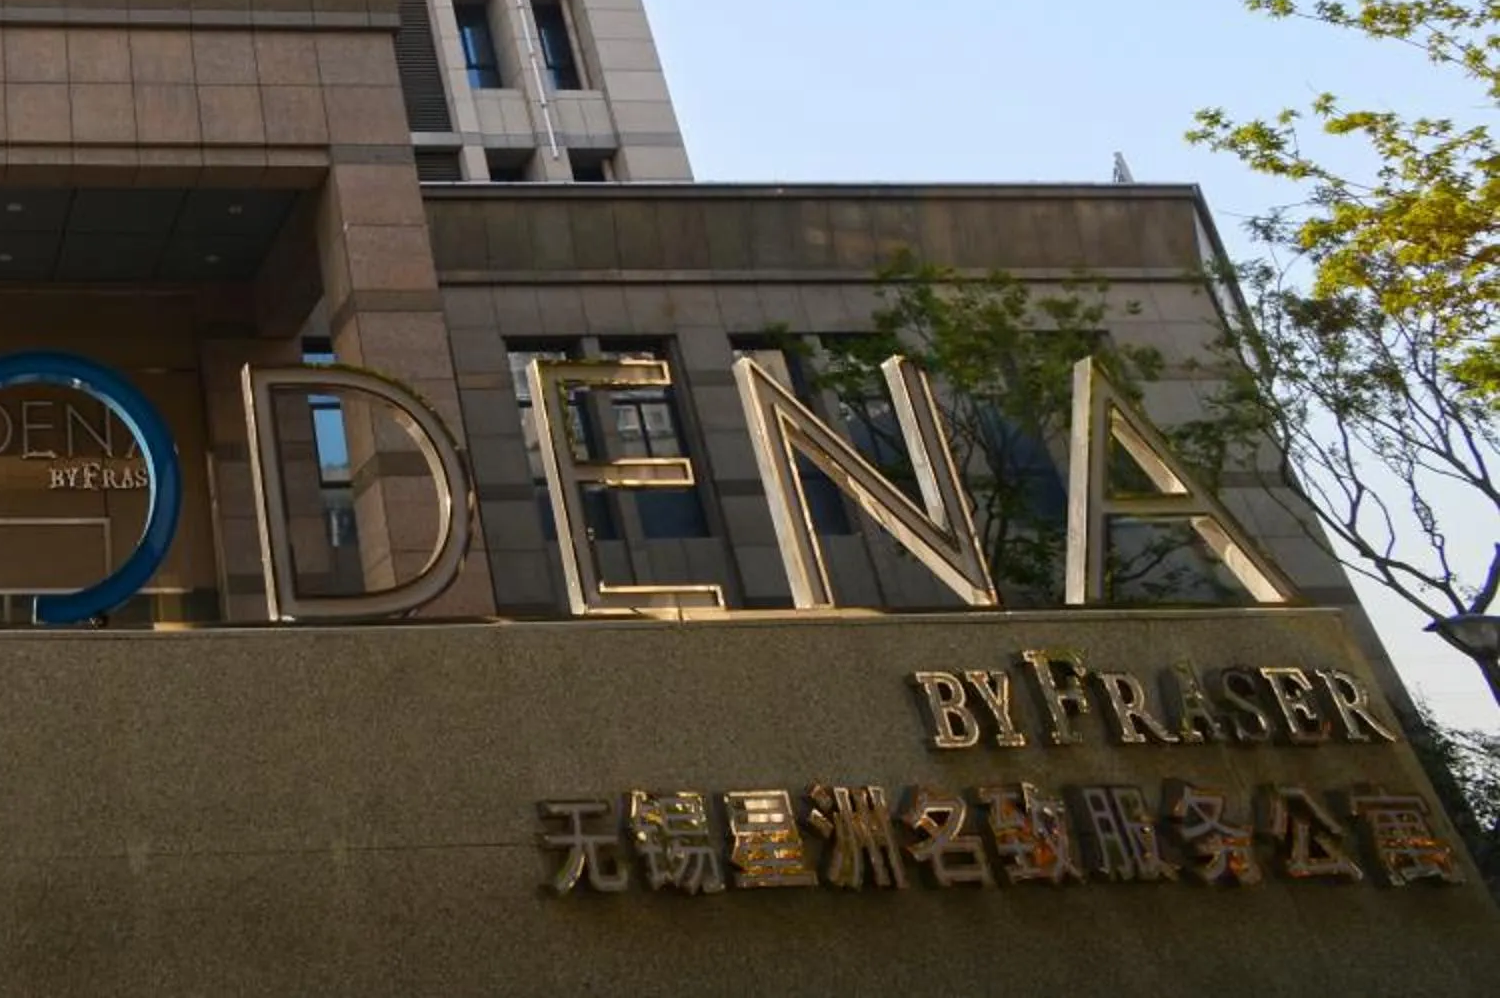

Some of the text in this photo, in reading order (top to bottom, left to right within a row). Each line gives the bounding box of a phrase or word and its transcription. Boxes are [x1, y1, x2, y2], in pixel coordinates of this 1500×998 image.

[49, 462, 149, 490] BY FRAS
[915, 649, 1397, 748] BY FRASER
[543, 782, 1466, 893] 无锡星洲名致服务公寓
